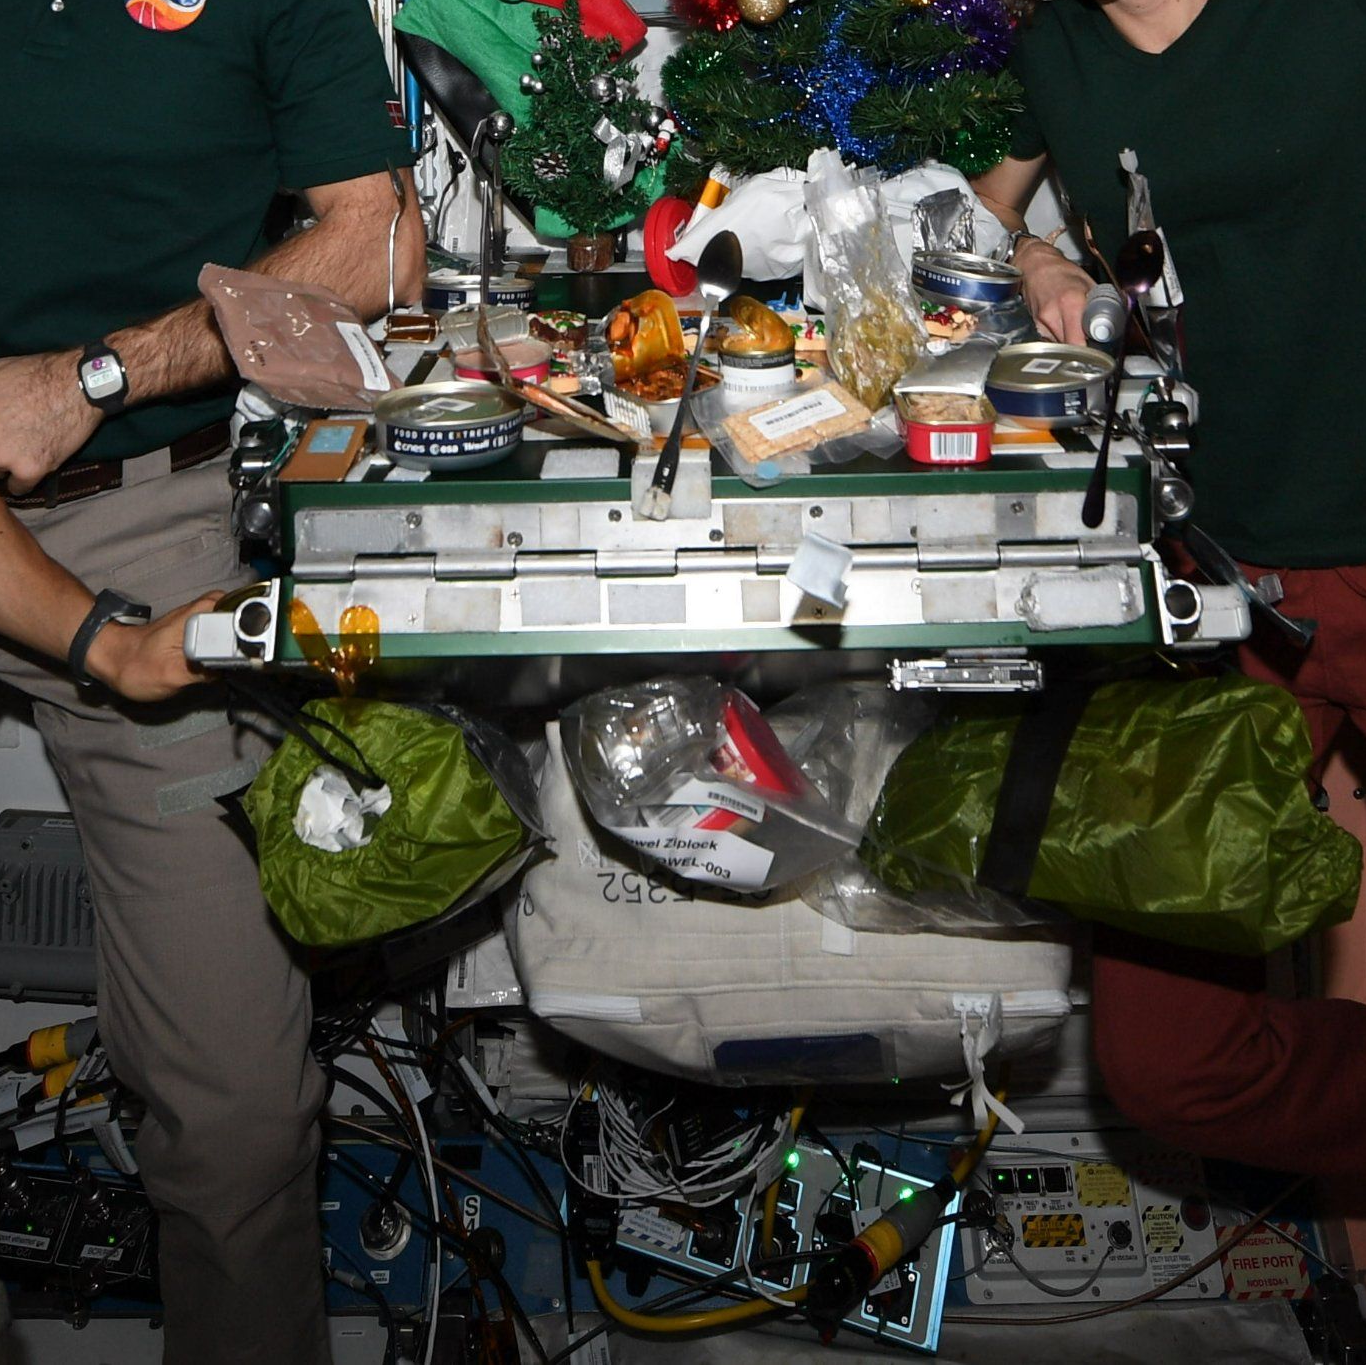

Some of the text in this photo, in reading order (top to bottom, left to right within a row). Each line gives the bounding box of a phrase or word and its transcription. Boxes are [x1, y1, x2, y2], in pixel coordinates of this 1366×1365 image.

[927, 272, 962, 287] DUCASSE
[395, 428, 418, 440] FOOD
[423, 431, 443, 441] FOR
[448, 426, 496, 441] EXTREME
[664, 837, 717, 851] Ziplock
[1147, 1213, 1175, 1221] CAUTION
[1233, 1255, 1294, 1271] FIRE PORT
